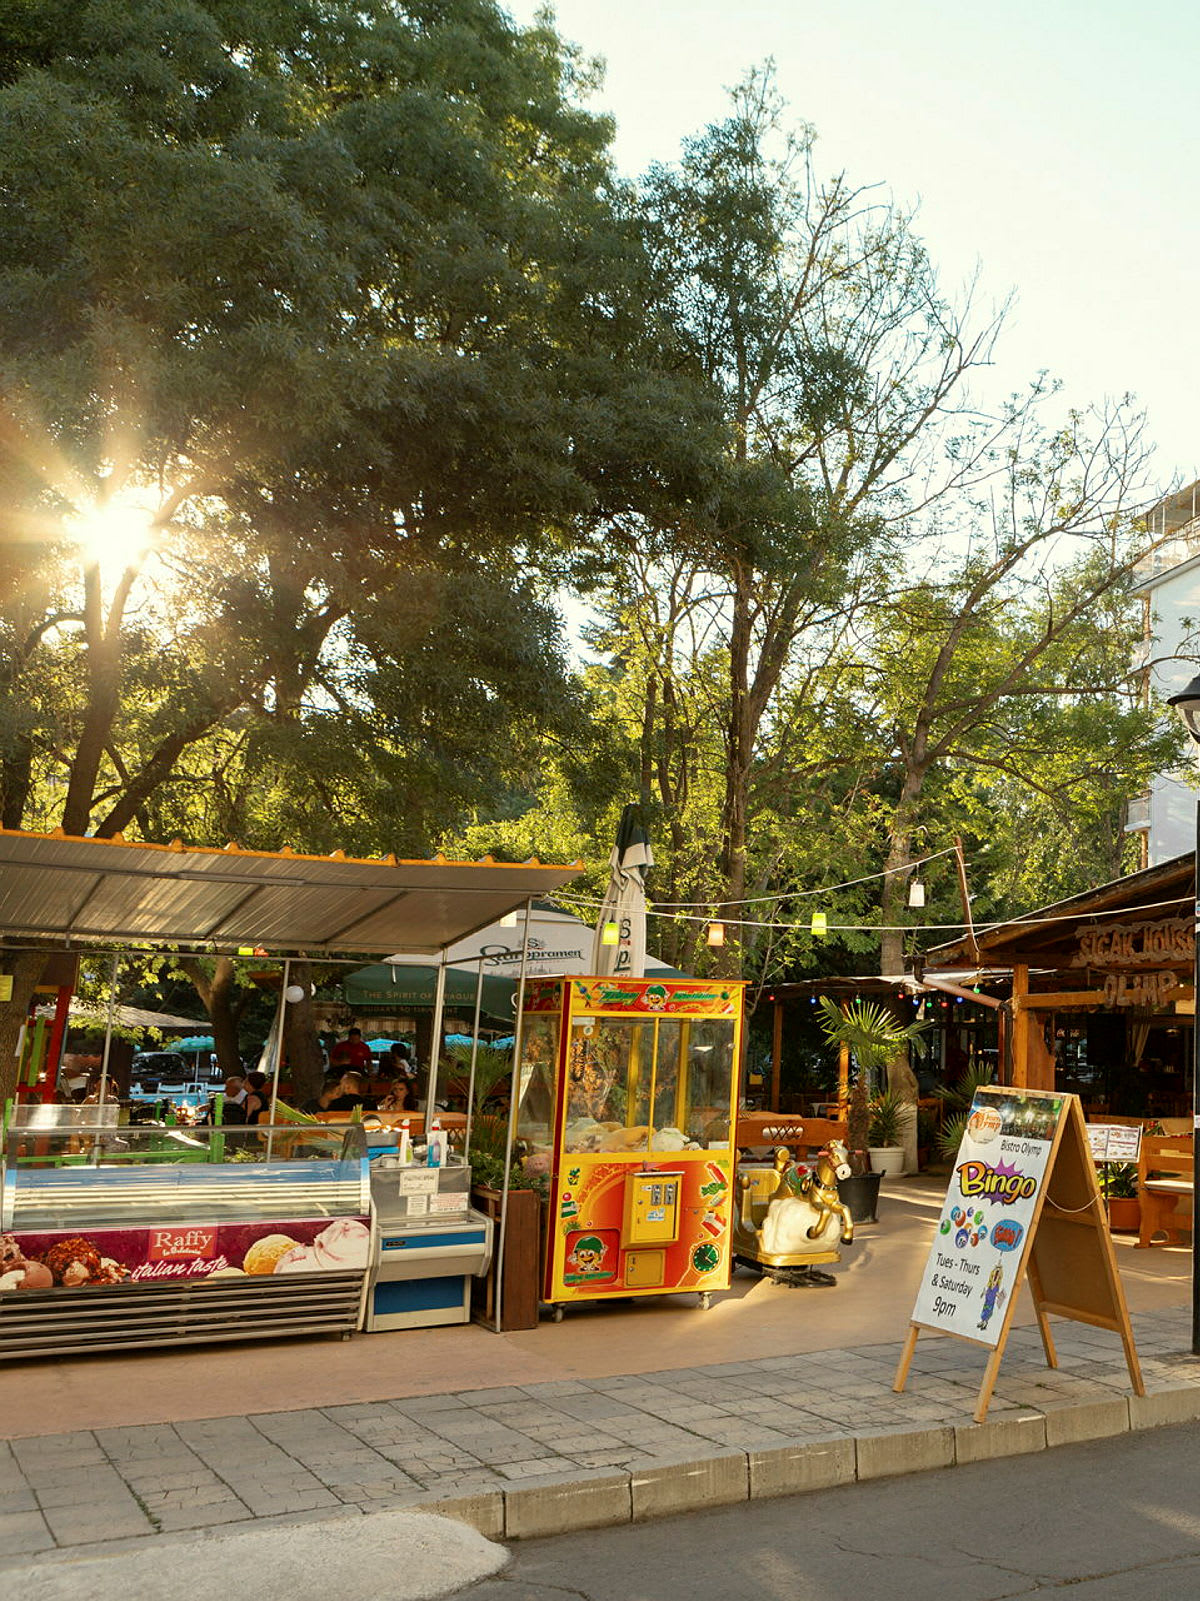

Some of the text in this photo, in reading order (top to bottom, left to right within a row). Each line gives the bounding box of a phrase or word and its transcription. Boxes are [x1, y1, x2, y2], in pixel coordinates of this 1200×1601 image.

[1001, 1139, 1042, 1158] Bistro Olymp
[957, 1161, 1037, 1204] Bingo
[154, 1230, 213, 1249] Raffy
[131, 1254, 229, 1280] italian taste
[935, 1252, 954, 1268] Tues
[960, 1258, 980, 1275] Thurs
[931, 1273, 973, 1298] & Saturday
[932, 1296, 957, 1317] 9pm
